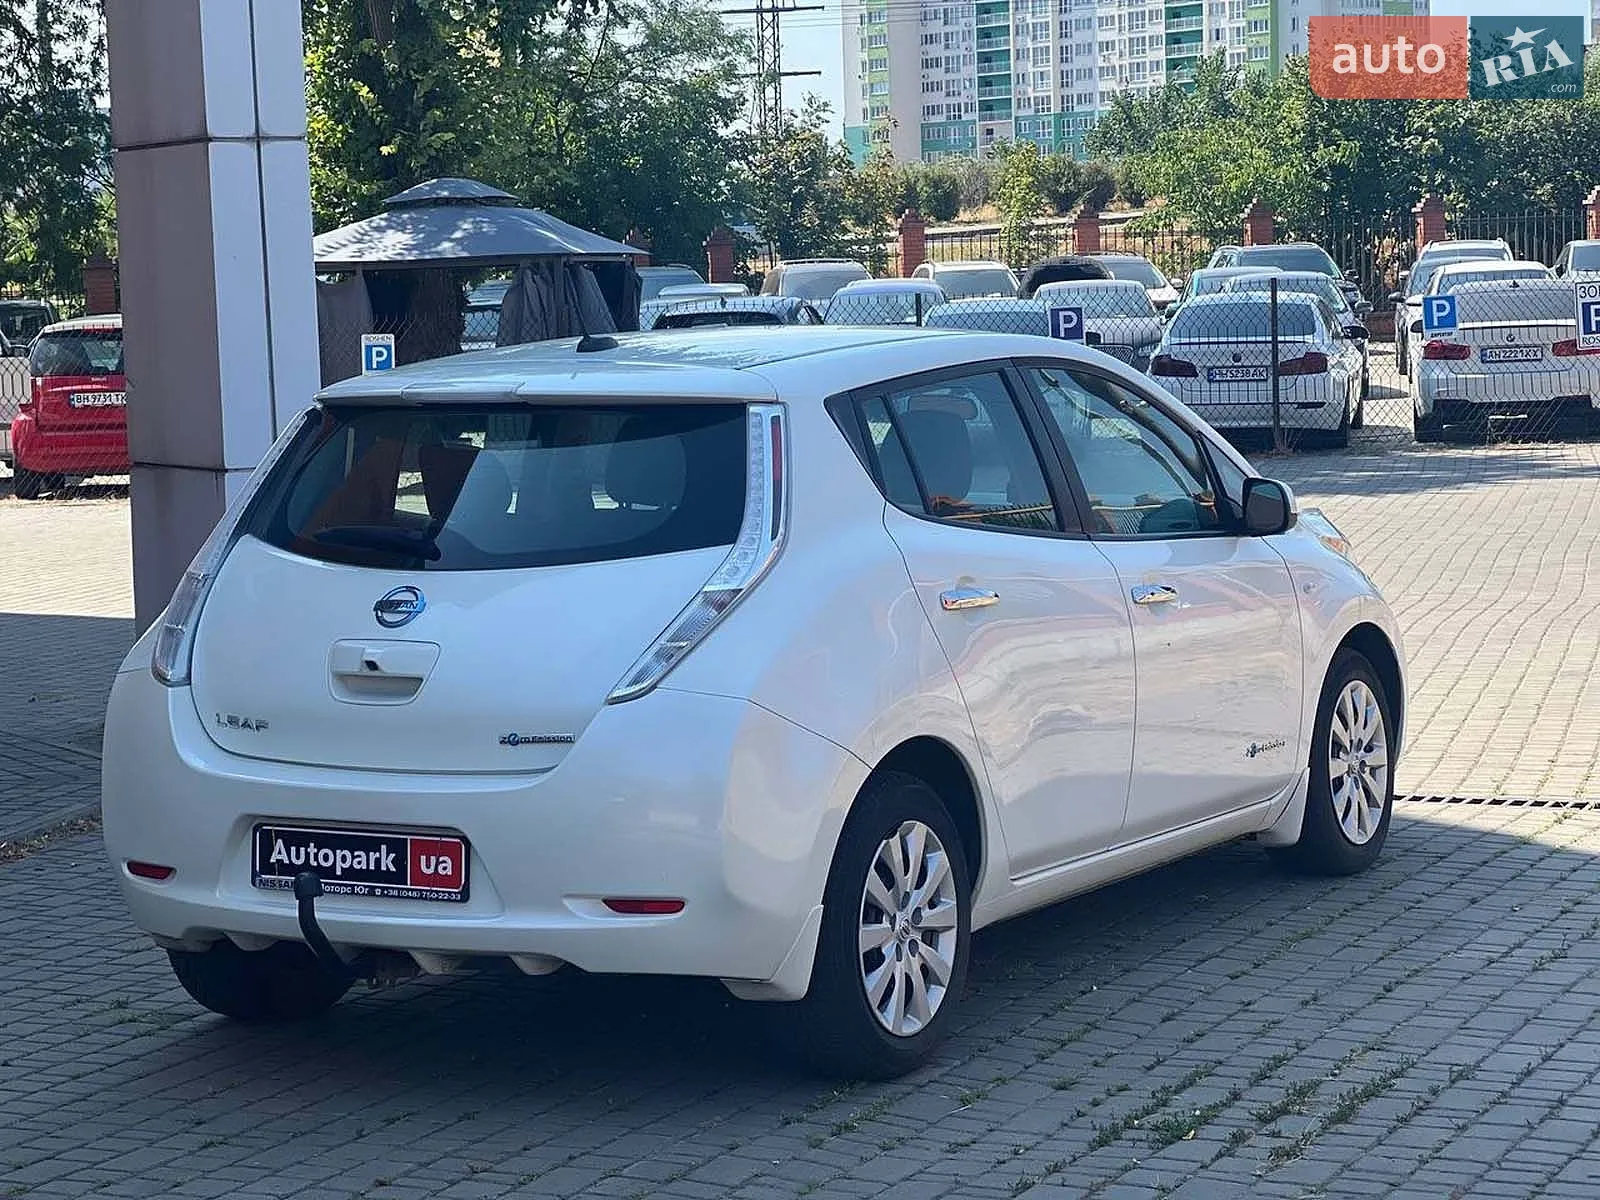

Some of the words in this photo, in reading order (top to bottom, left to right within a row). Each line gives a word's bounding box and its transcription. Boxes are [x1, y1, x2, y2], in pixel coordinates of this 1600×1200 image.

[1059, 310, 1078, 338] P
[1432, 299, 1451, 326] P
[372, 346, 388, 369] P
[269, 838, 397, 876] Autopark
[420, 855, 453, 875] ua
